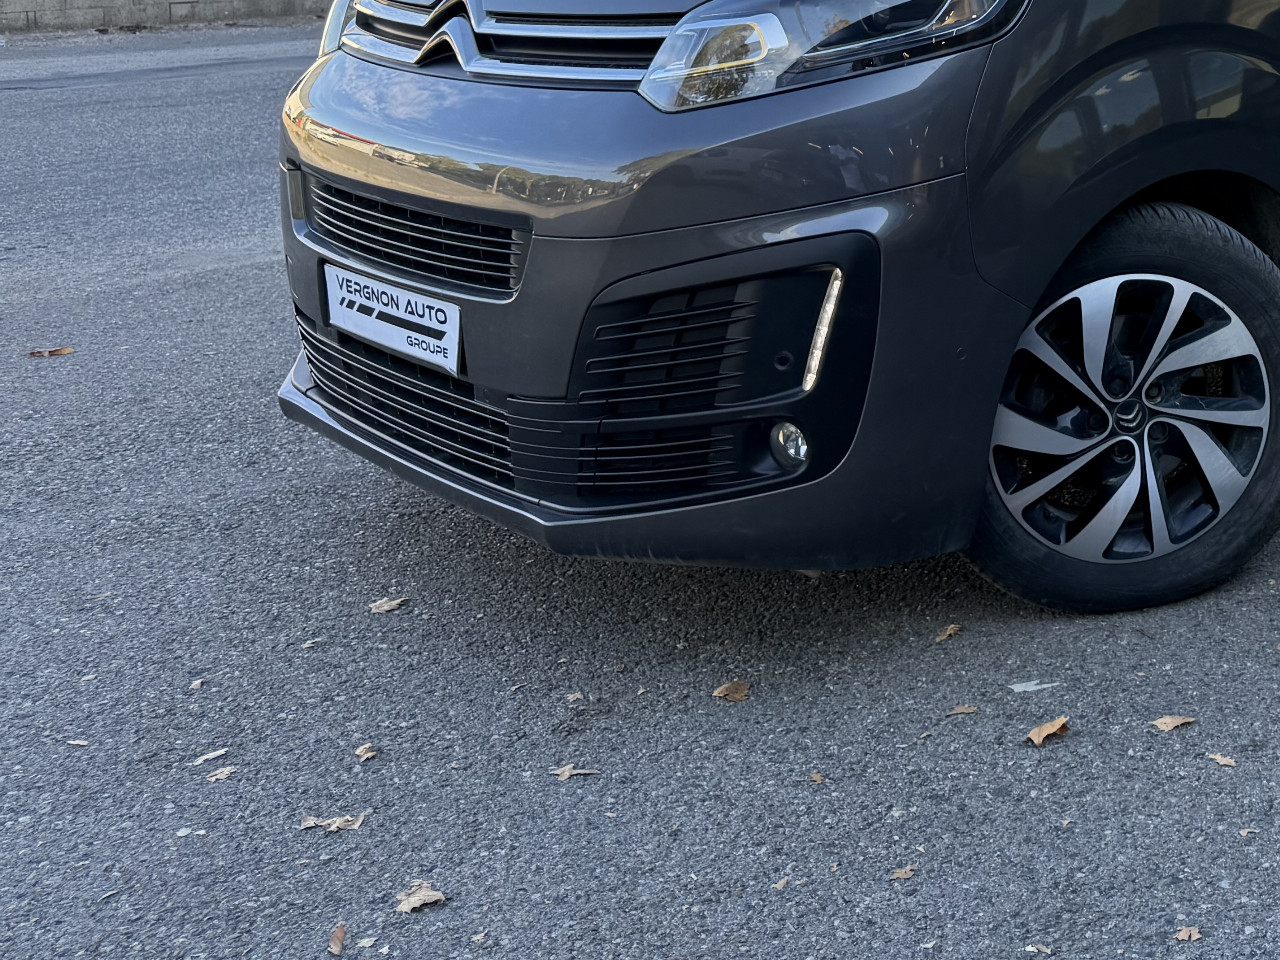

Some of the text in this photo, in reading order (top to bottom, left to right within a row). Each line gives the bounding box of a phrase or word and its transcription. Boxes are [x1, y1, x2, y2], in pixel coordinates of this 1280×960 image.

[335, 273, 448, 325] VERGNON AUTO
[406, 335, 449, 359] GROUPE
